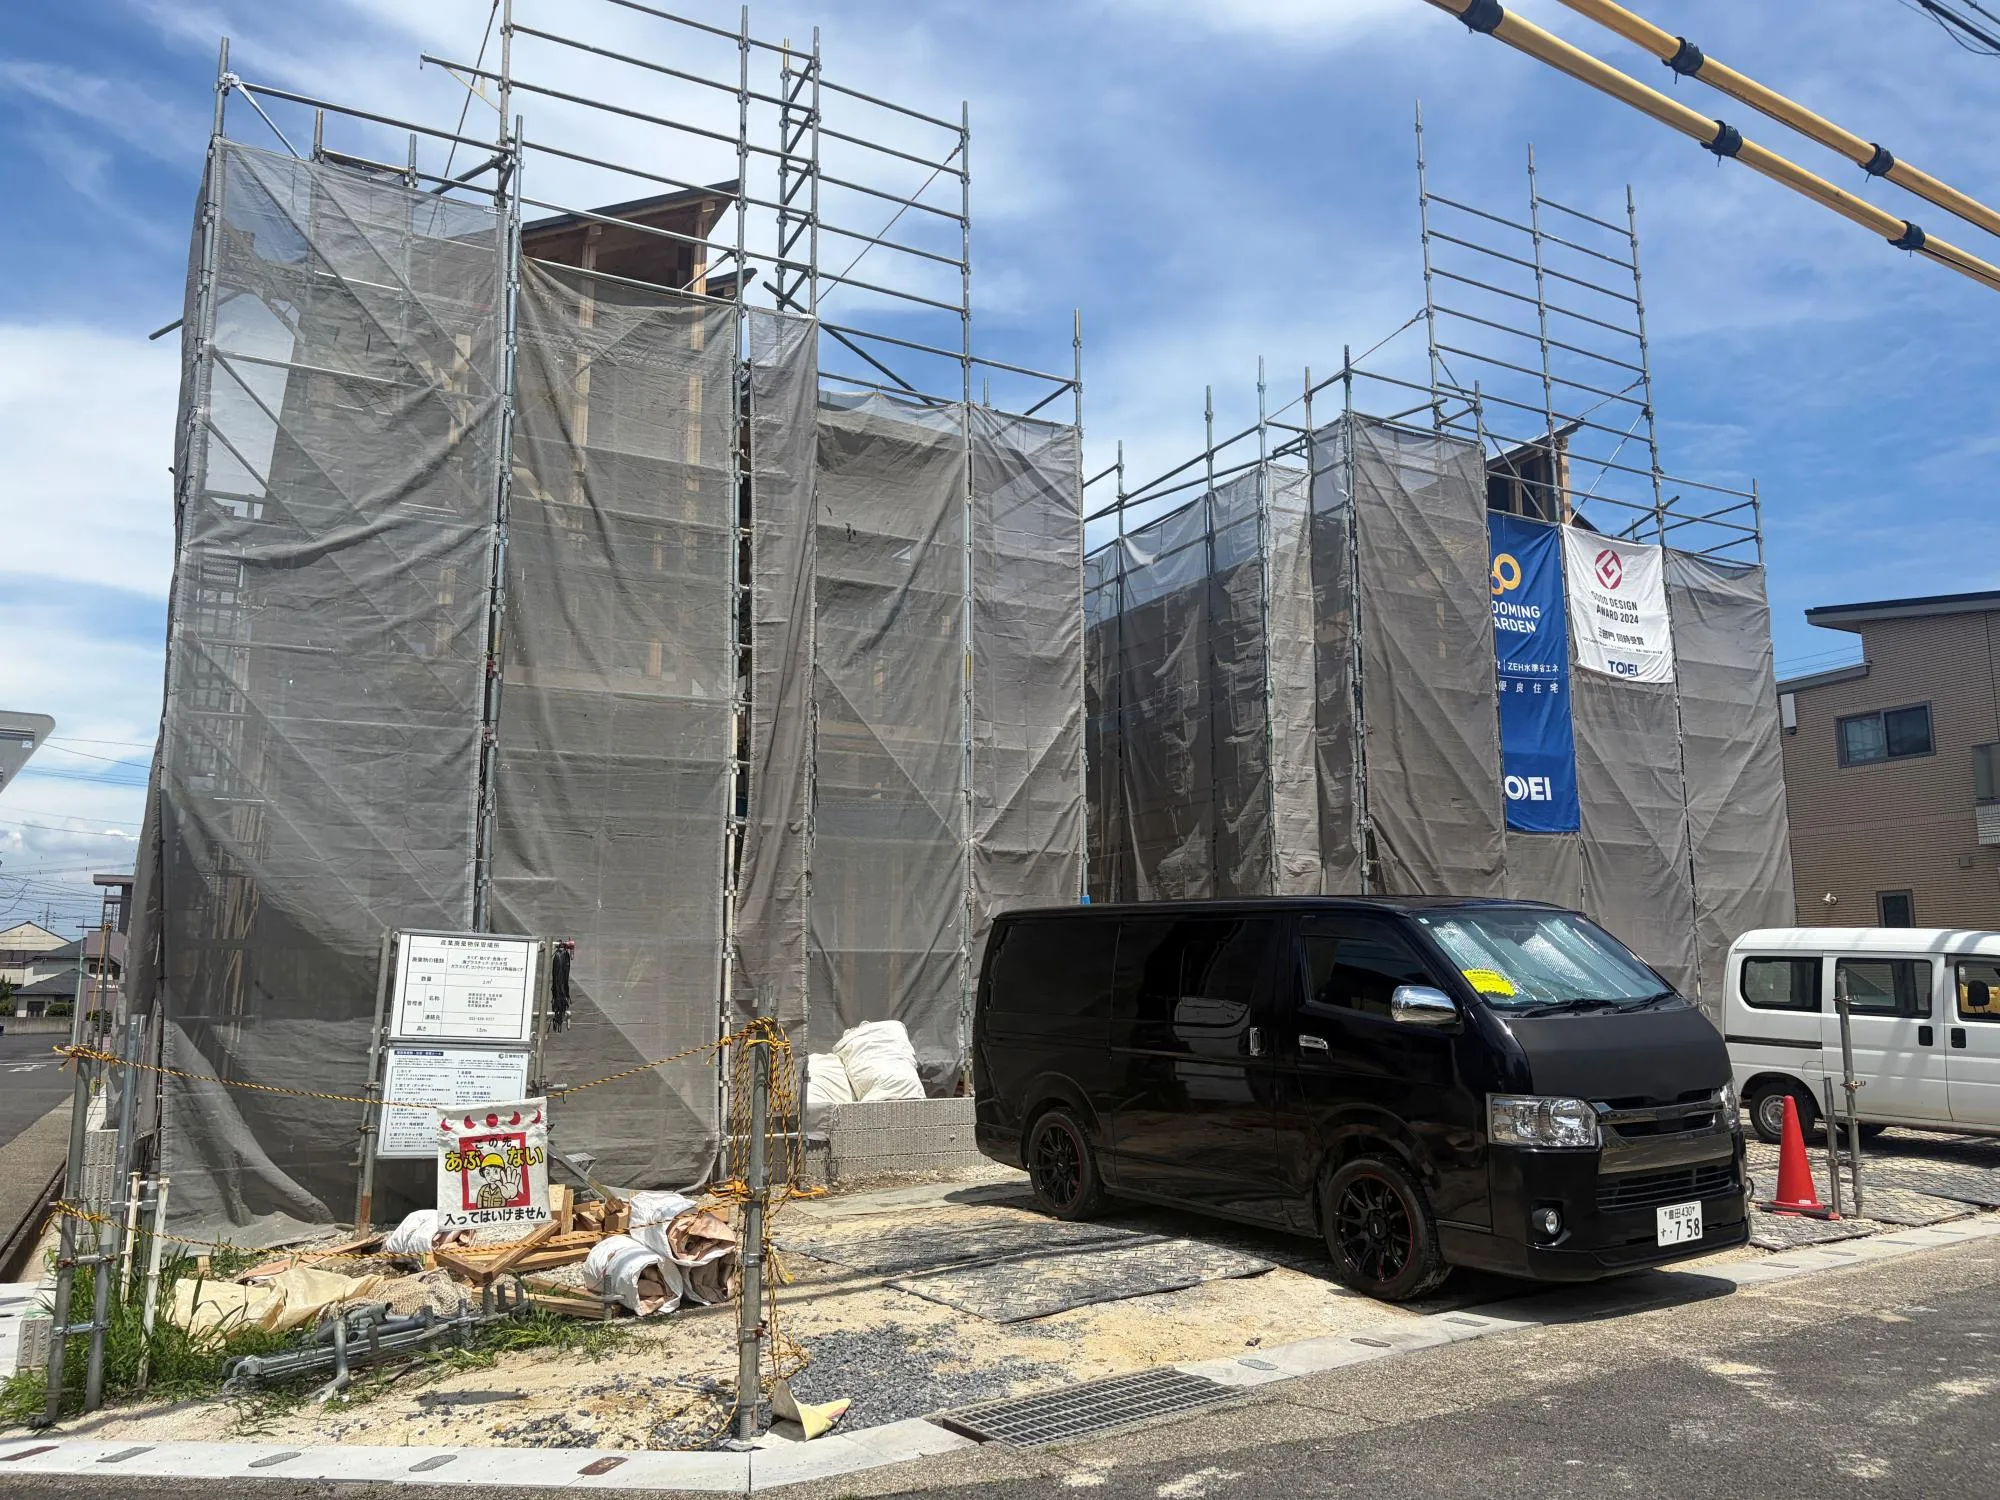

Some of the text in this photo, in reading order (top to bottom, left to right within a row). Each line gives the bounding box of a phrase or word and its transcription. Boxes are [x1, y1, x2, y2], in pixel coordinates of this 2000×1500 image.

[1609, 597, 1638, 611] DESIGN
[1596, 605, 1639, 624] AWARD 2024
[475, 1136, 512, 1149] この先
[444, 1207, 547, 1226] 入ってはいけません
